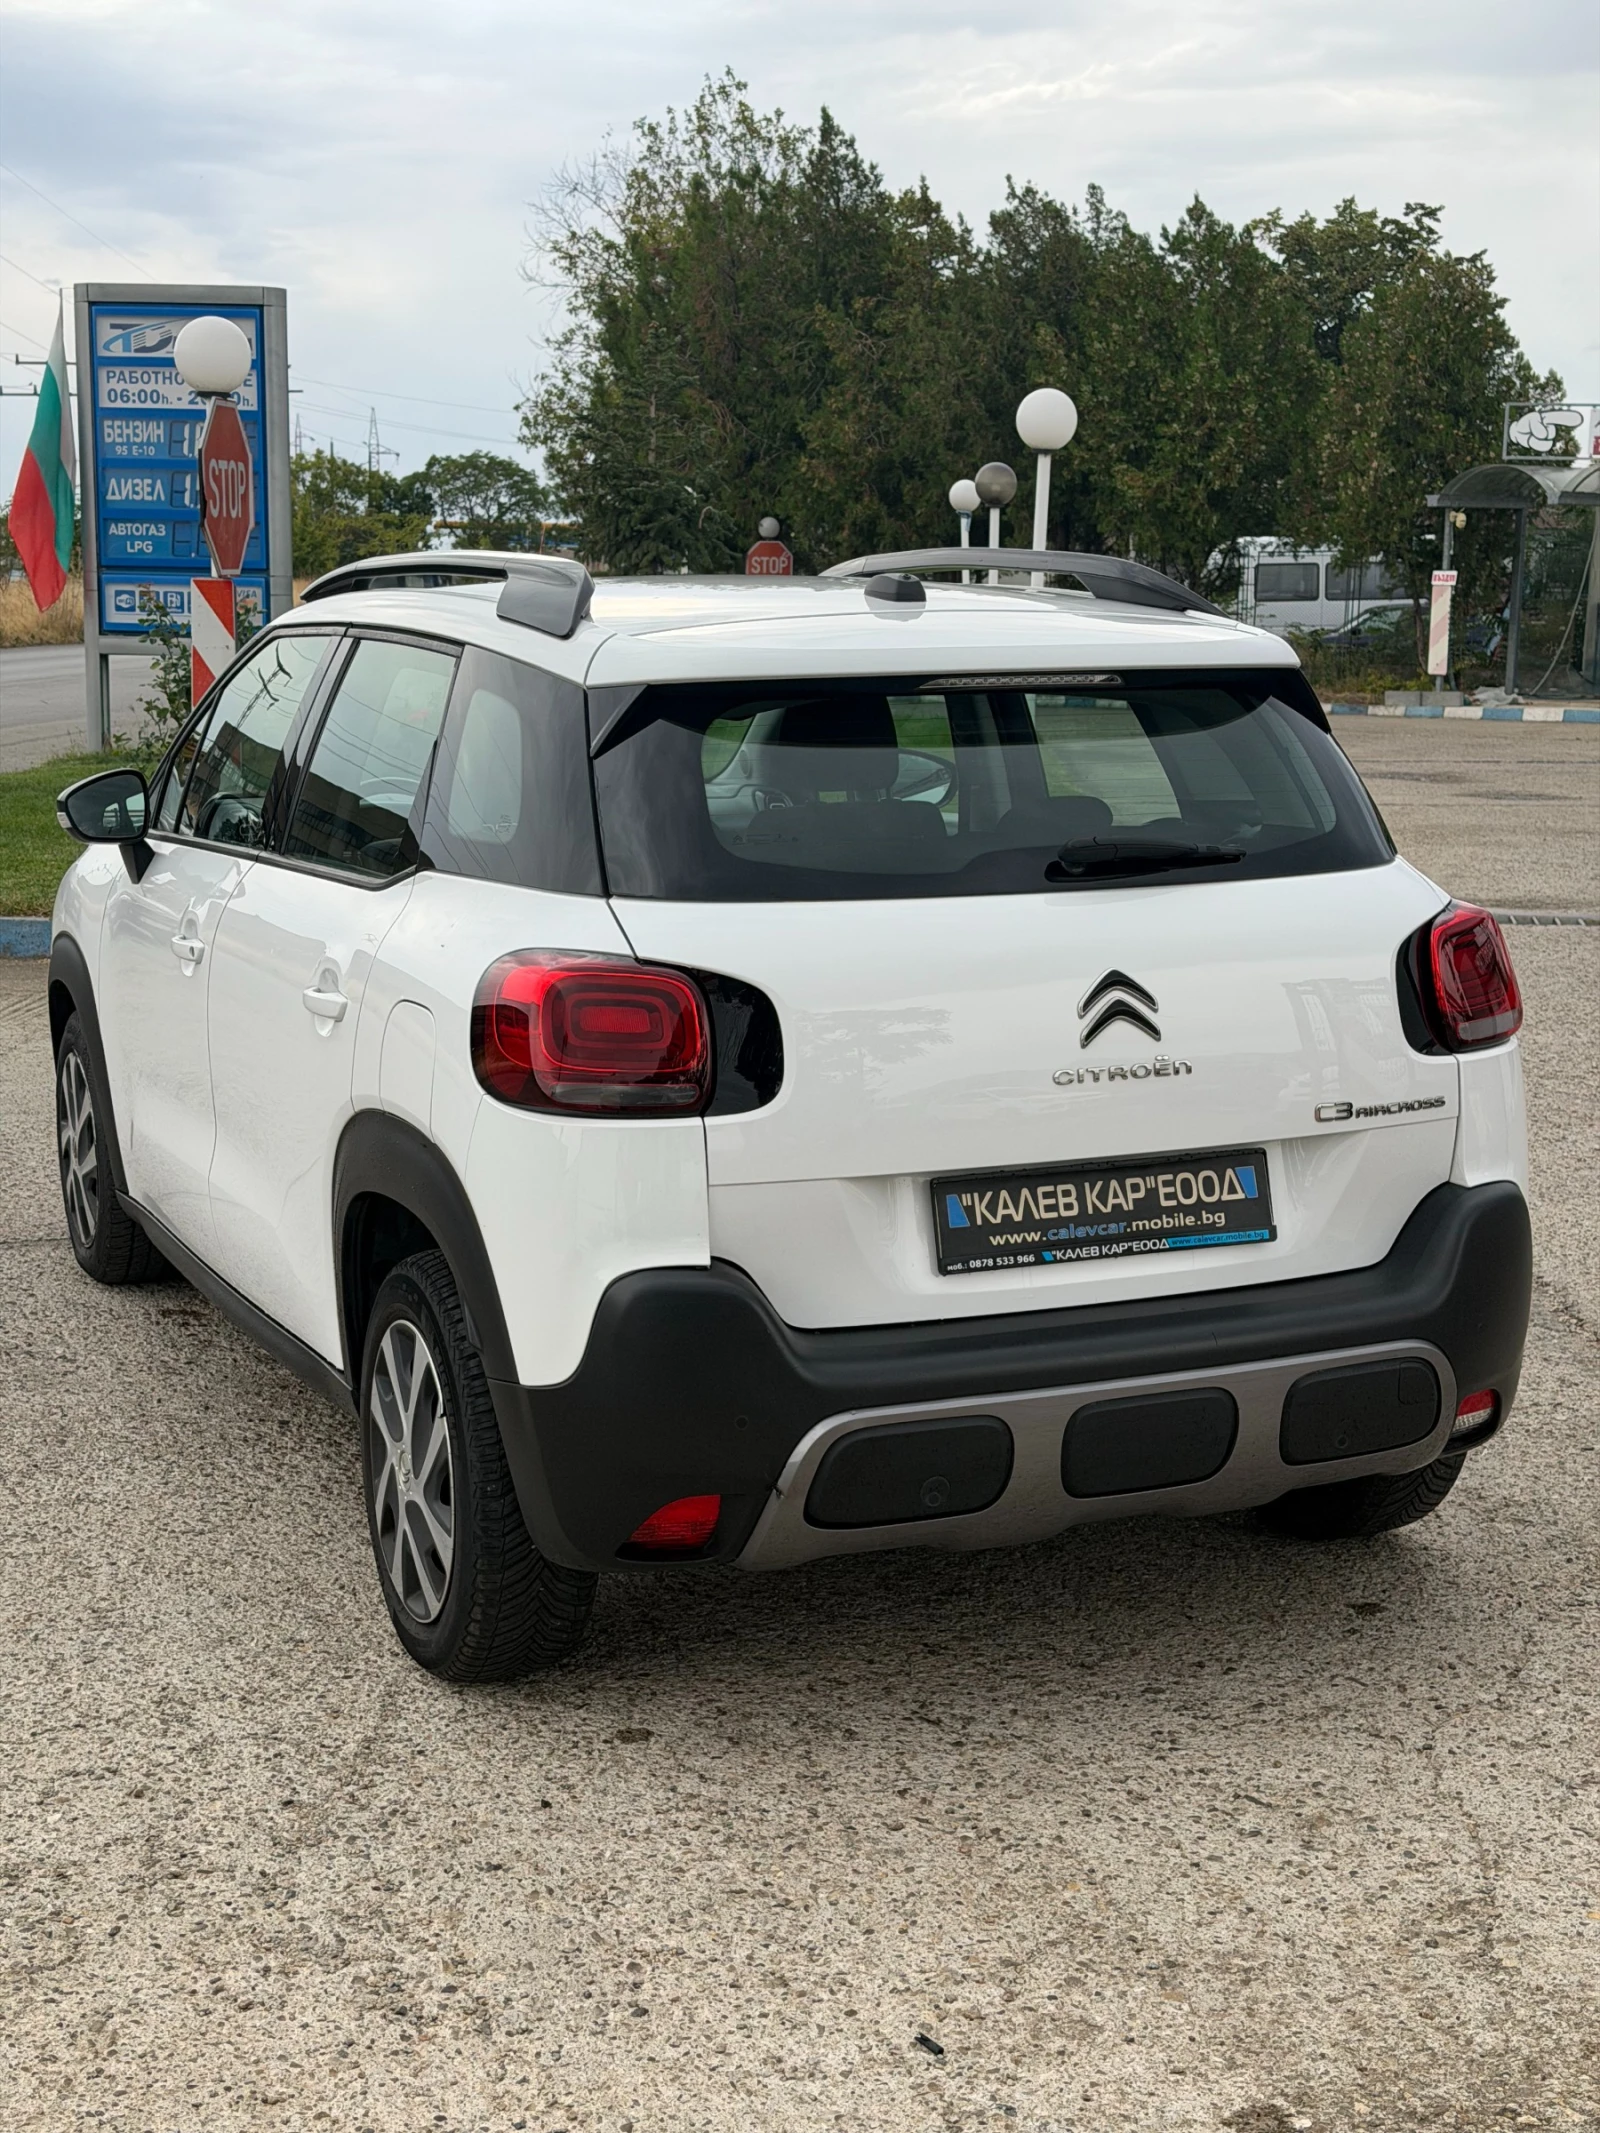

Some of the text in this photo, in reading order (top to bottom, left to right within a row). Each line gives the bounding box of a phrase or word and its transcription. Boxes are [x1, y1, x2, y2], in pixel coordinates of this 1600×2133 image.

[106, 370, 185, 386] РАБОТНО
[107, 388, 173, 405] 06:00h.
[103, 420, 165, 443] БЕНЗИН
[115, 445, 128, 455] 95
[105, 477, 165, 501] ДИЗЕЛ
[209, 458, 247, 519] STOP
[108, 522, 166, 536] АВТОГАЗ
[126, 541, 153, 553] LPG
[751, 556, 788, 574] STOP
[1314, 1096, 1446, 1123] C3 AIRCROSS
[989, 1210, 1226, 1246] www.calevcar.mobile.bg
[969, 1258, 993, 1269] 0878
[996, 1256, 1014, 1266] 533
[1017, 1254, 1035, 1264] 966
